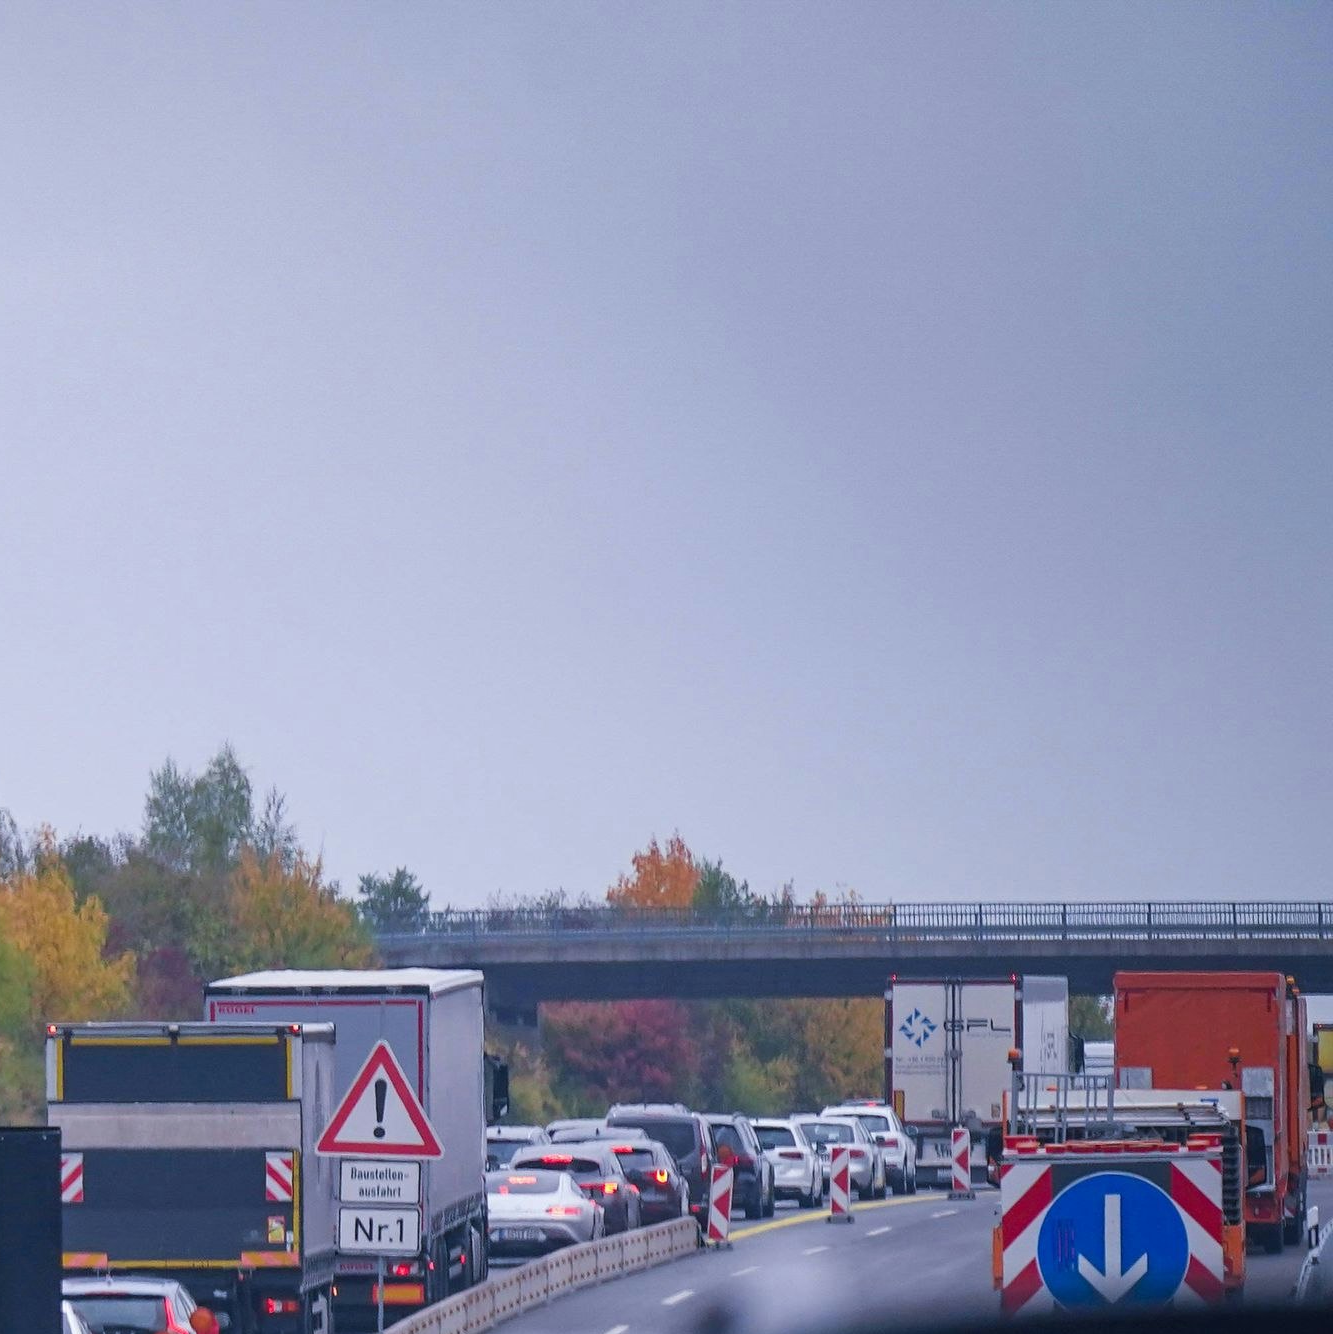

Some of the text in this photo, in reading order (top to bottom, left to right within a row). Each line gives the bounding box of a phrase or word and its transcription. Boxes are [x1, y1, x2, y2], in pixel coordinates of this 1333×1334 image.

[943, 1018, 1012, 1032] GFL
[350, 1167, 410, 1181] Baustellen-
[358, 1185, 402, 1198] ausfahrt
[354, 1216, 404, 1243] Nr.1
